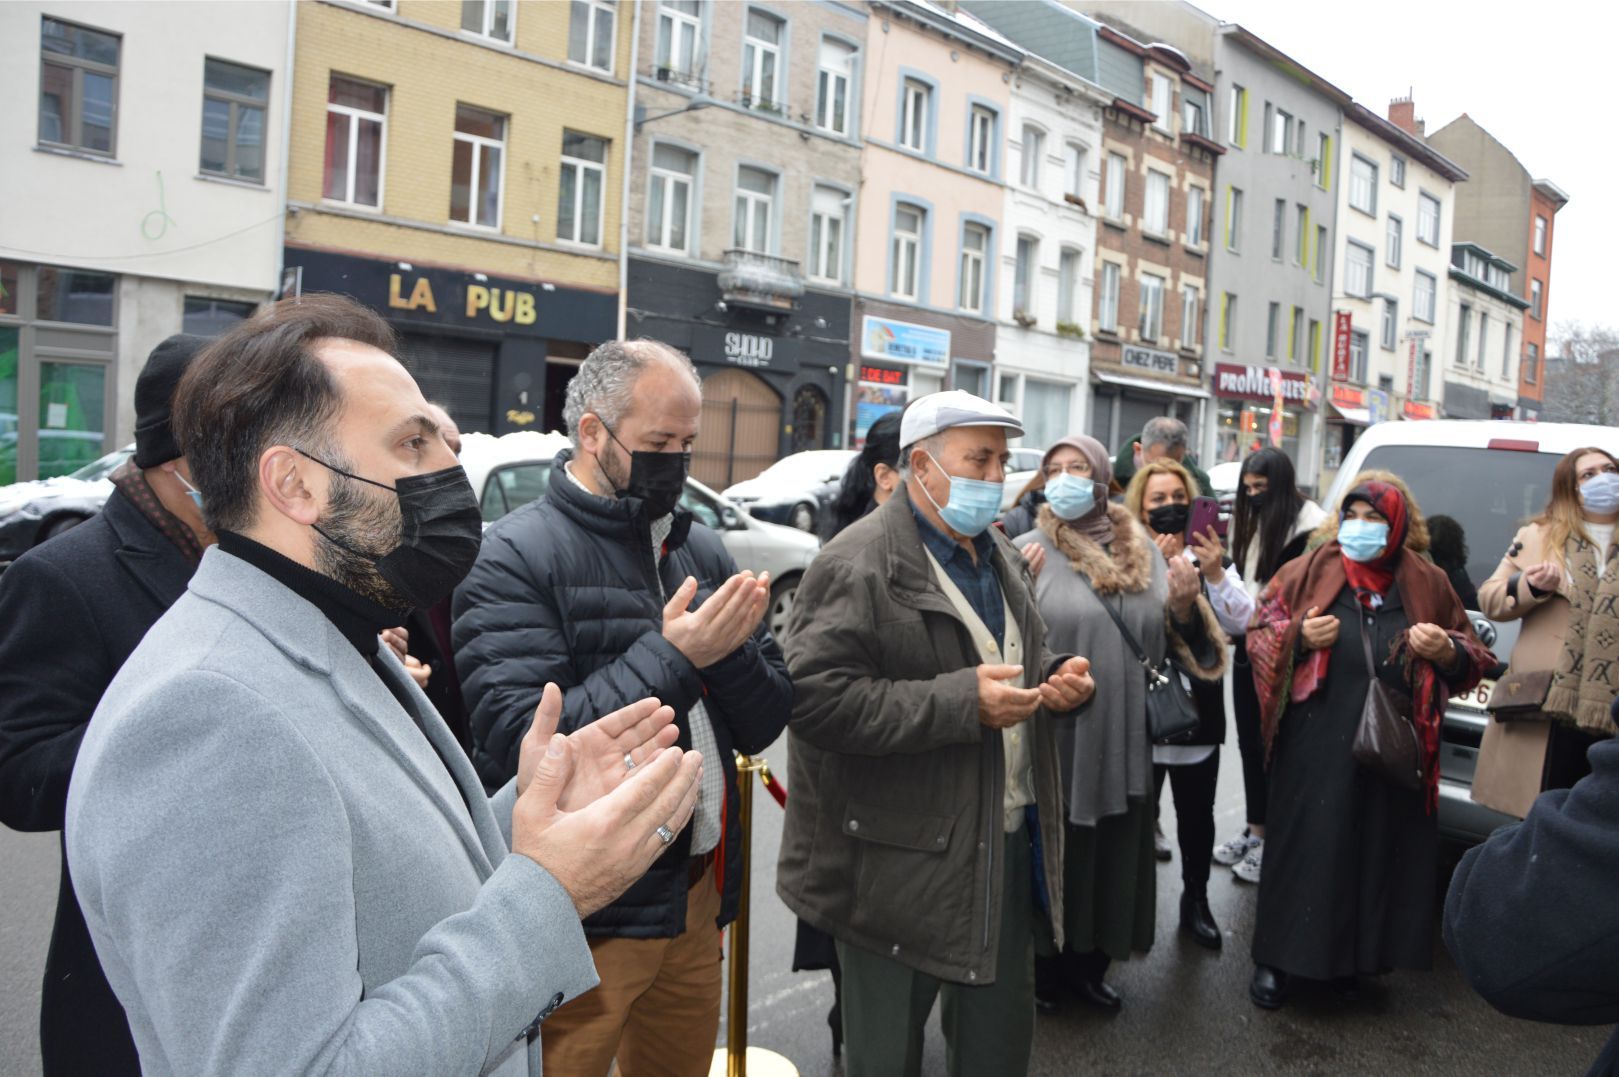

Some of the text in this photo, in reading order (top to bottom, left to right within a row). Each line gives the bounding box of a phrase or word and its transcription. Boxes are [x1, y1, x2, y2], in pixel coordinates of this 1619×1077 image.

[389, 273, 537, 325] LA PUB
[1124, 348, 1150, 367] CHEZ
